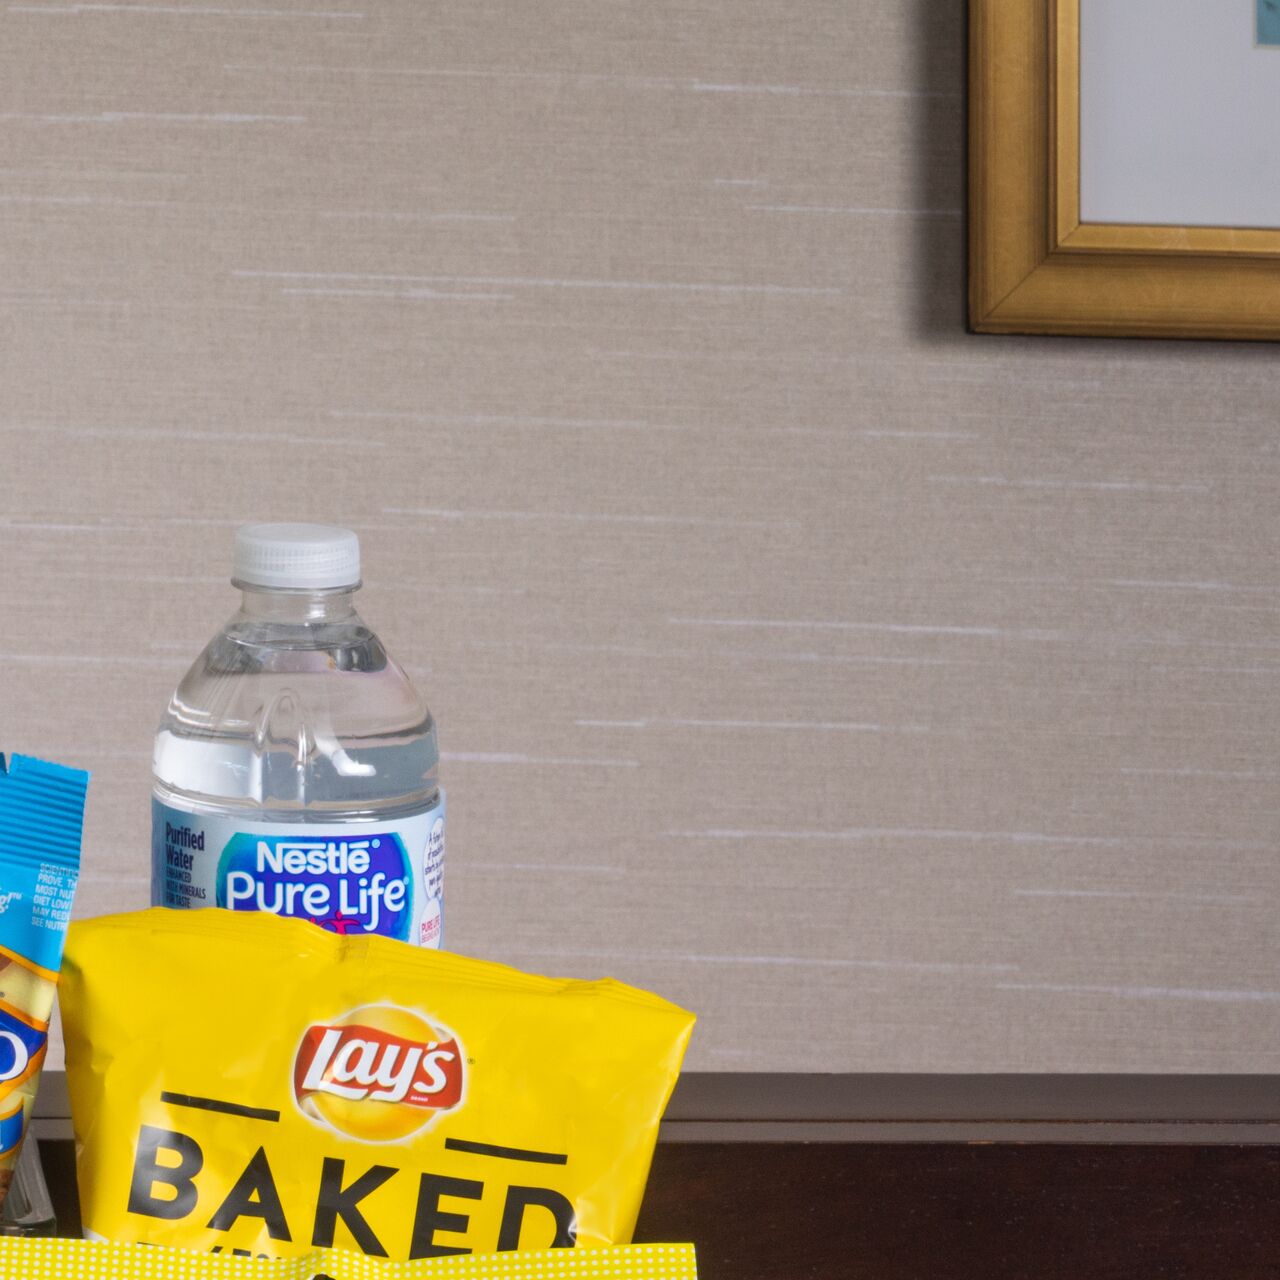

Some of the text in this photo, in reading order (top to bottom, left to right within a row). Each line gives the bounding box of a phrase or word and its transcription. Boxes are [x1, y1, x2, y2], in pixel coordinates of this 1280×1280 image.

[165, 821, 205, 851] Purified
[165, 843, 194, 870] Water
[256, 840, 371, 875] Nestlé
[226, 871, 408, 931] Pure Life
[301, 1027, 454, 1104] Lay's
[126, 1124, 577, 1261] BAKED
